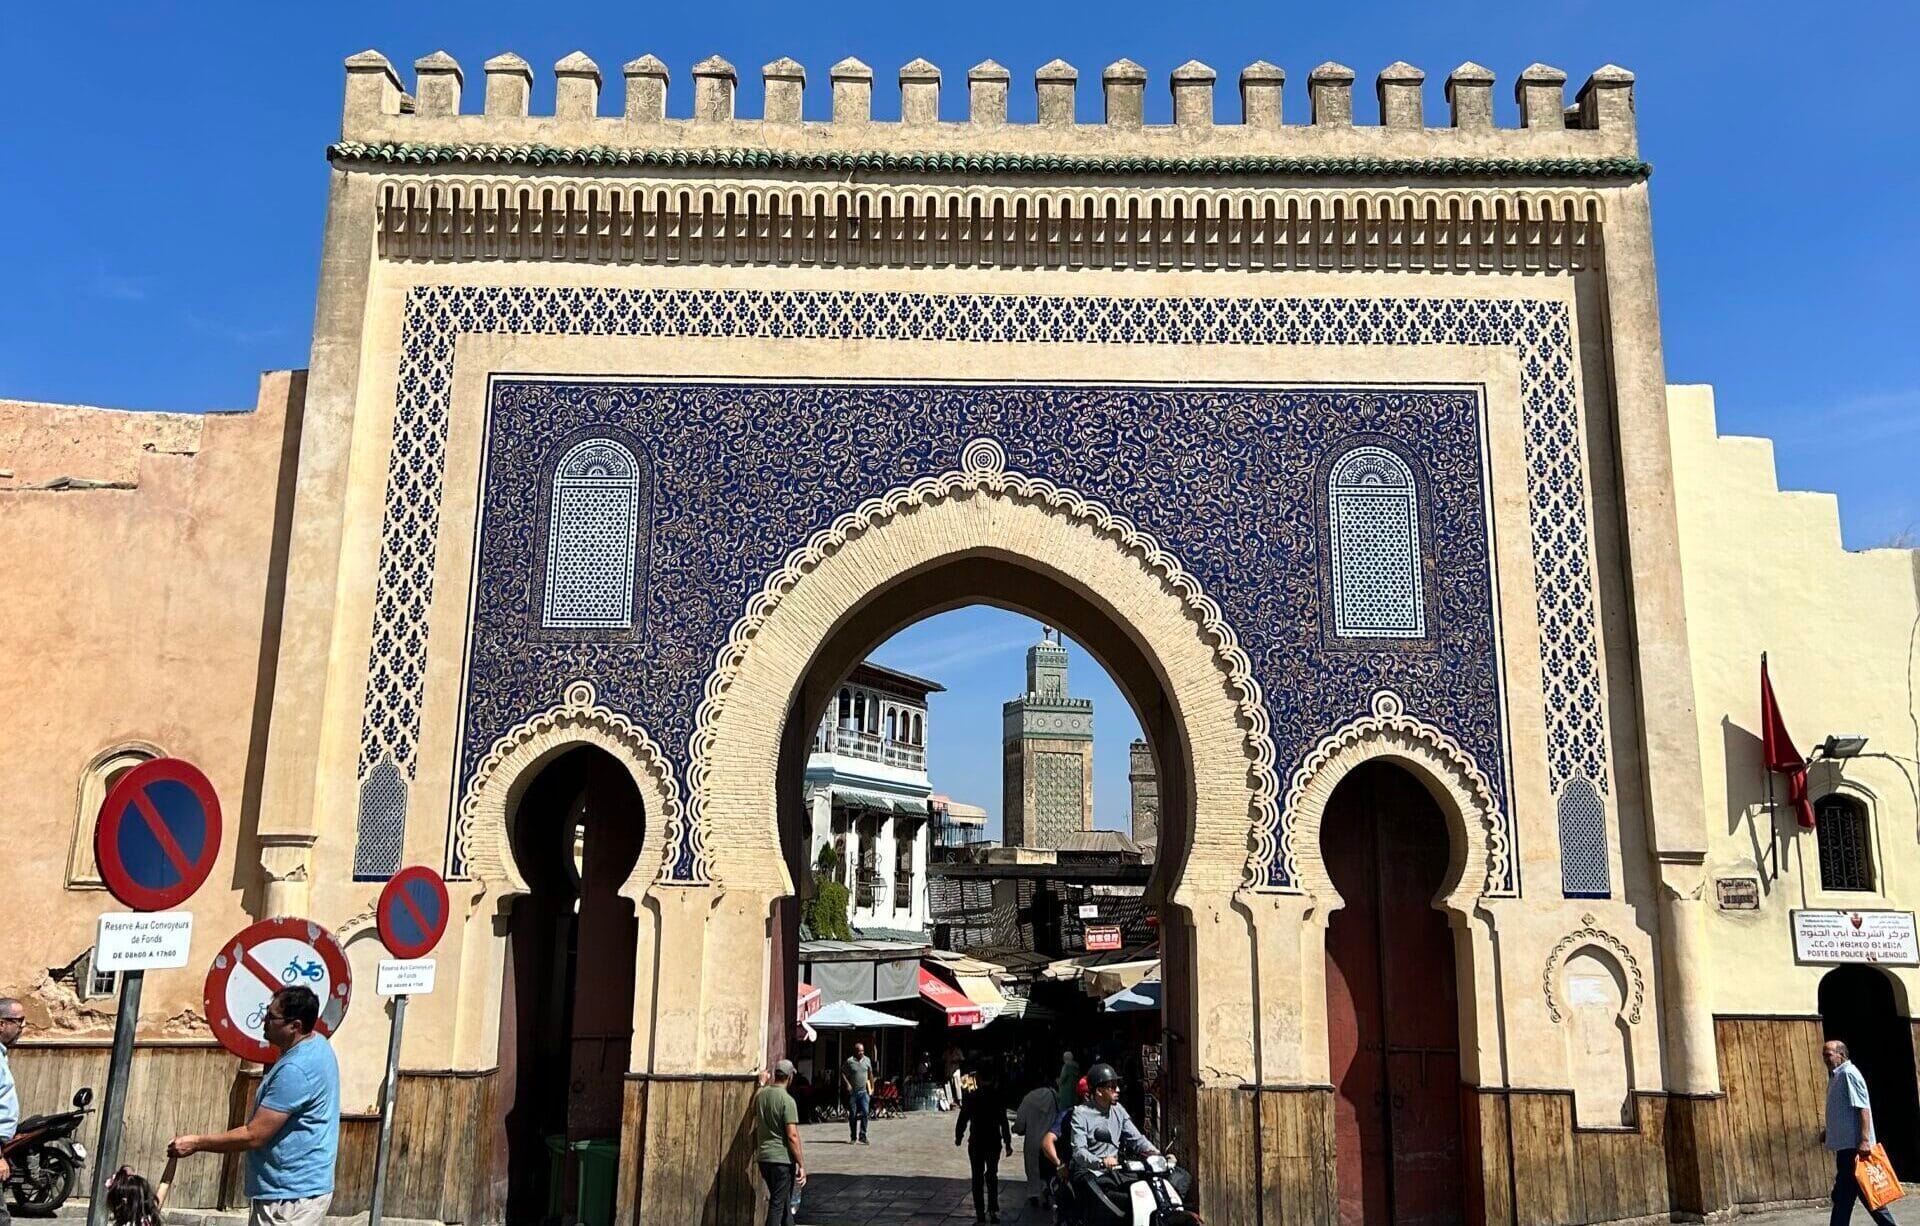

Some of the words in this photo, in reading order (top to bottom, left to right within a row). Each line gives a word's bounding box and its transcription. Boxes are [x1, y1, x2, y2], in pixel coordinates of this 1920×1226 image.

[135, 921, 148, 930] Aux
[150, 920, 189, 932] Convoyeurs
[131, 935, 140, 944] de
[141, 934, 162, 943] Fonds
[1852, 929, 1885, 939] الشرطة
[1888, 930, 1910, 939] مركز
[1840, 950, 1864, 958] POLICE
